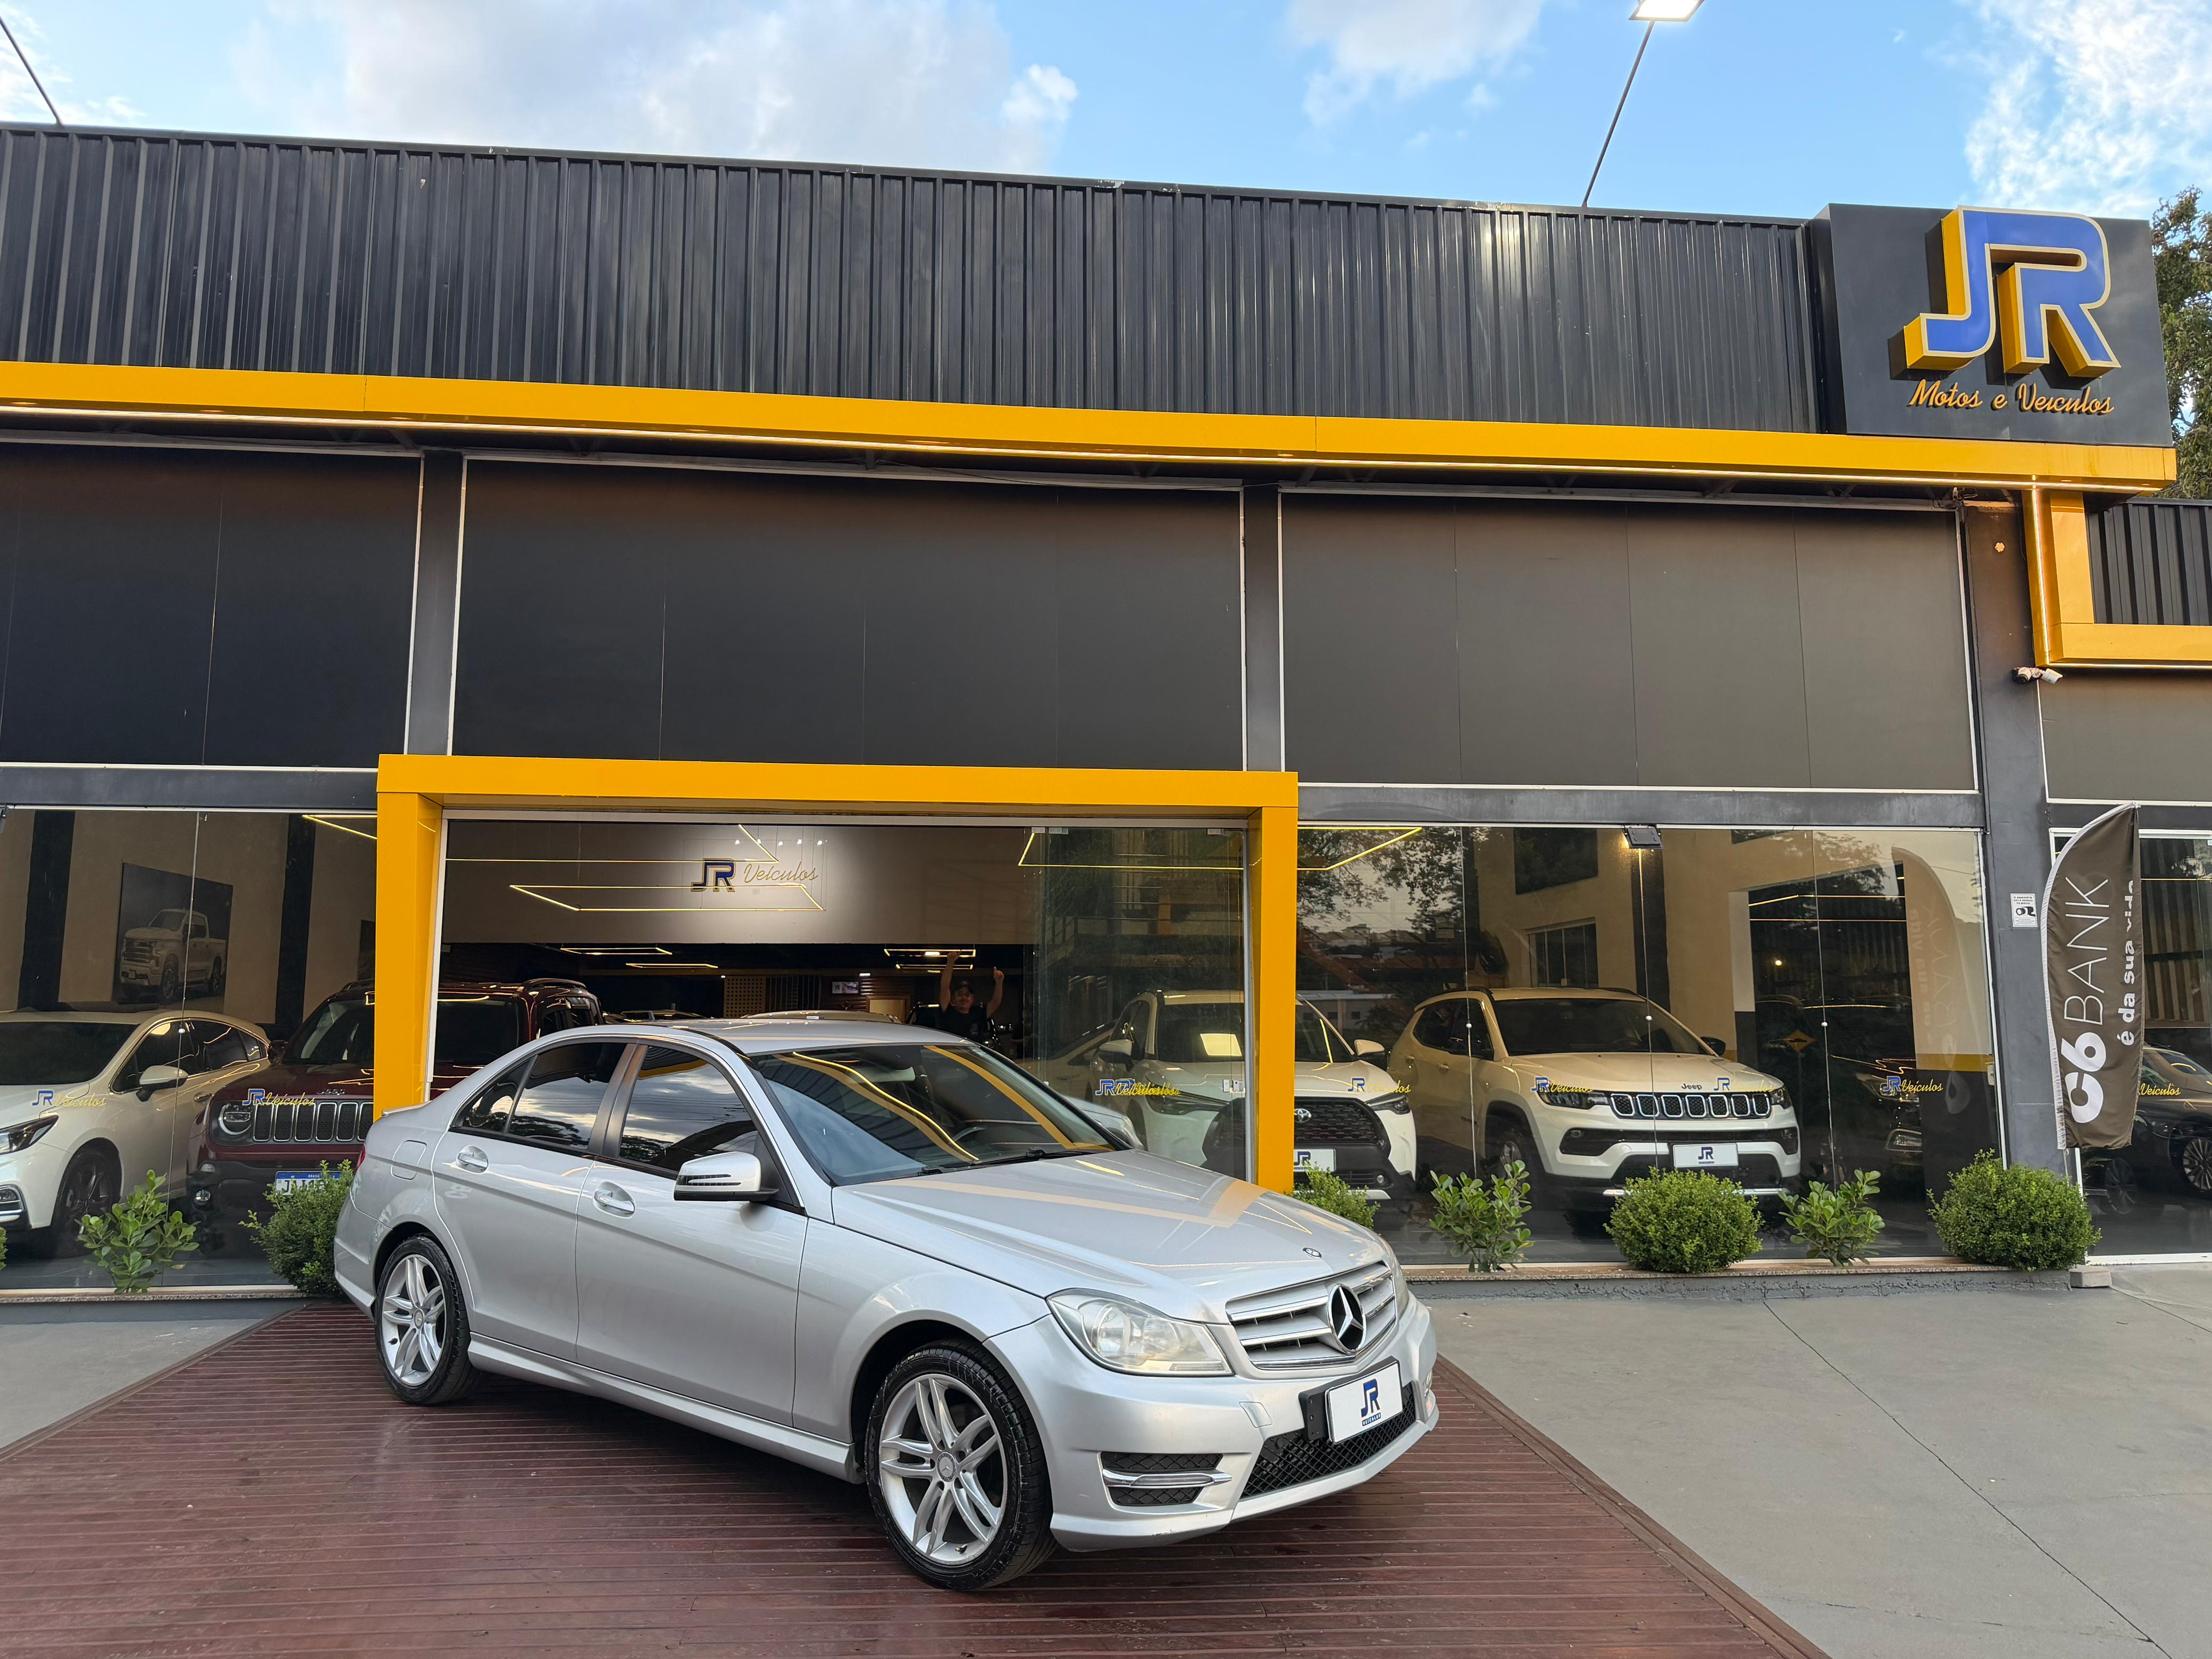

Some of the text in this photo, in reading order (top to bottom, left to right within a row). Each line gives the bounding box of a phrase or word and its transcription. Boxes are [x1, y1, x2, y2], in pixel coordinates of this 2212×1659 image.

[1905, 205, 2121, 376] JR
[1909, 379, 1983, 408] Motos
[1992, 394, 2008, 409] e
[691, 858, 735, 892] JR
[2124, 940, 2135, 984] sua
[2061, 877, 2109, 1124] C6 BANK
[2118, 993, 2135, 1023] da
[2117, 1030, 2135, 1046] é
[1095, 1079, 1116, 1096] JR
[1347, 1077, 1365, 1092] JR
[1532, 1076, 1550, 1092] JR
[1714, 1077, 1730, 1091] JR
[1883, 1076, 1901, 1092] JR
[2141, 1083, 2181, 1095] Veículos
[32, 1089, 54, 1106] JR
[242, 1088, 265, 1105] JR
[1698, 1146, 1714, 1160] JR
[1361, 1378, 1380, 1418] JR
